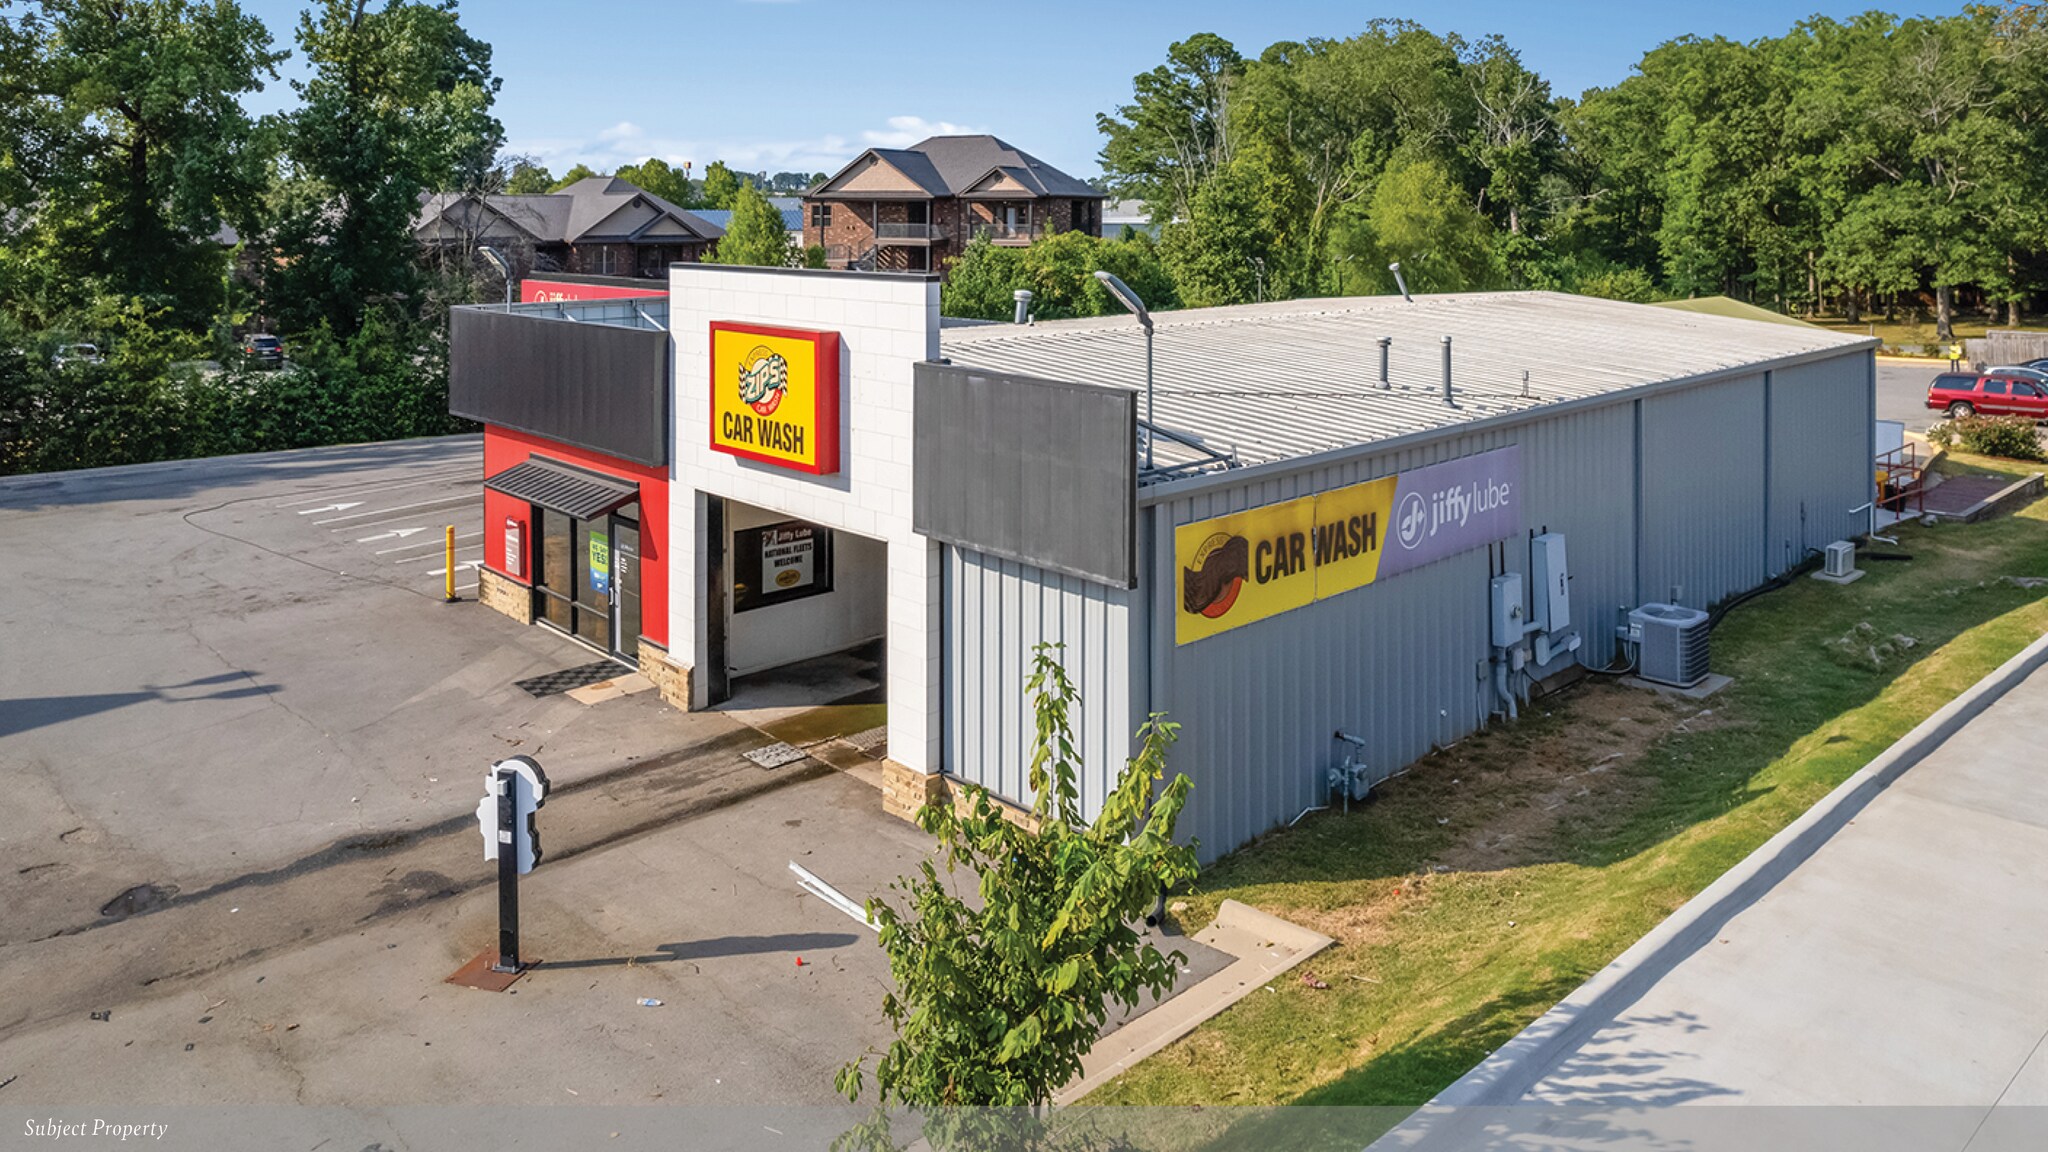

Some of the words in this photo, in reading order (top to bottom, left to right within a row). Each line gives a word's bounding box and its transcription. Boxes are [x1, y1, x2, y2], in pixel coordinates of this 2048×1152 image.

[746, 360, 780, 399] ZIPS
[723, 411, 754, 444] CAR
[757, 418, 804, 455] WASH
[1430, 485, 1472, 537] jiffy
[1473, 478, 1510, 514] lube
[774, 555, 803, 567] WELCOME
[1255, 531, 1306, 585] CAR
[1311, 512, 1377, 567] WASH
